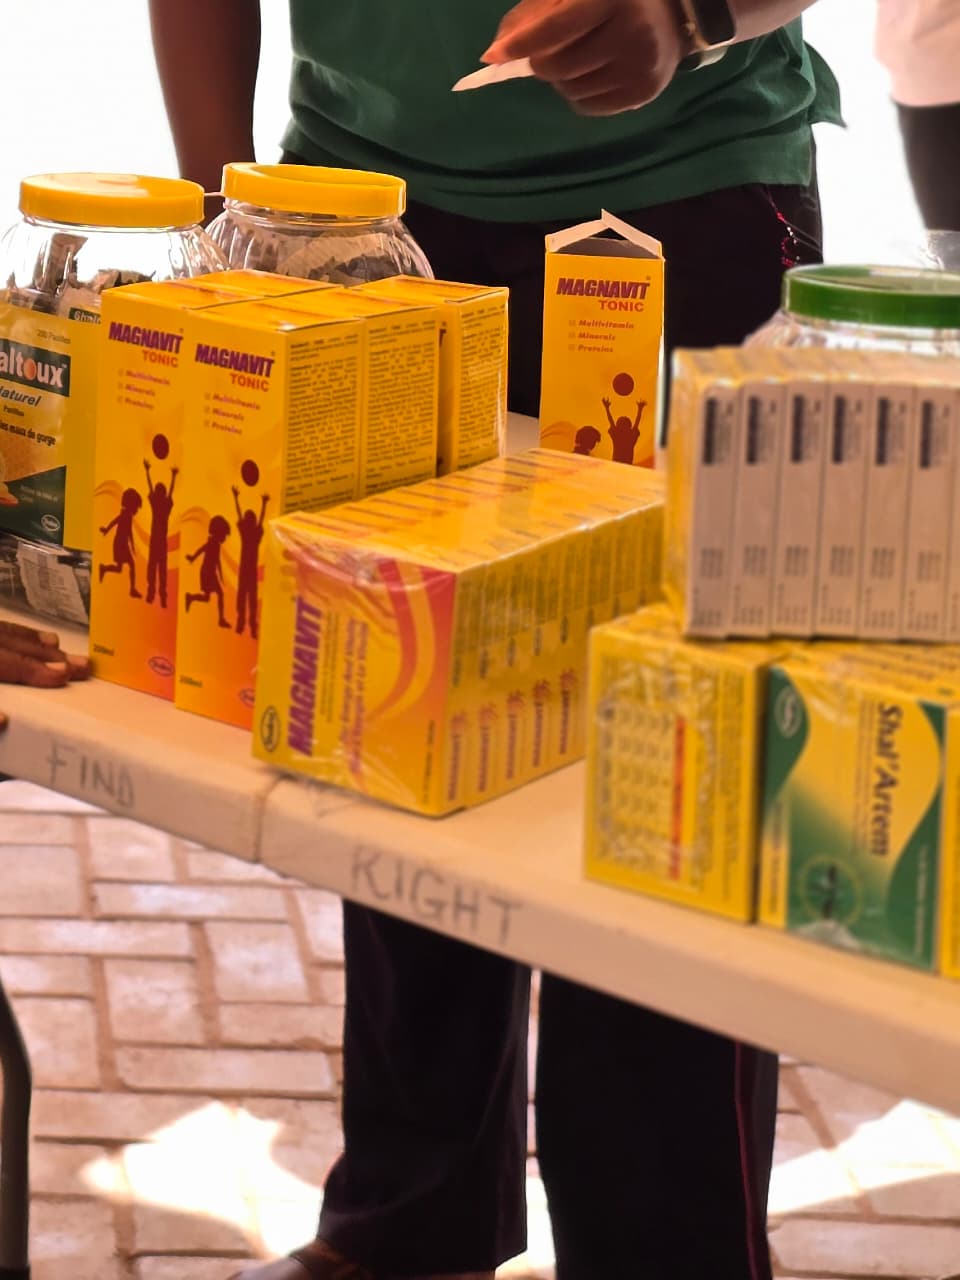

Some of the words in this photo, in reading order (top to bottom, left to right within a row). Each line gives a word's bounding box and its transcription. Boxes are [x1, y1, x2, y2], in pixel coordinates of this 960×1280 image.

[555, 277, 651, 300] MAGNAVIT
[598, 300, 645, 313] TONIC
[108, 321, 184, 355] MAGNAVIT
[142, 349, 179, 368] TONIC
[194, 343, 275, 379] MAGNAVIT
[230, 372, 270, 392] TONIC
[286, 594, 323, 758] MAGNAVIT
[45, 742, 135, 809] FIND
